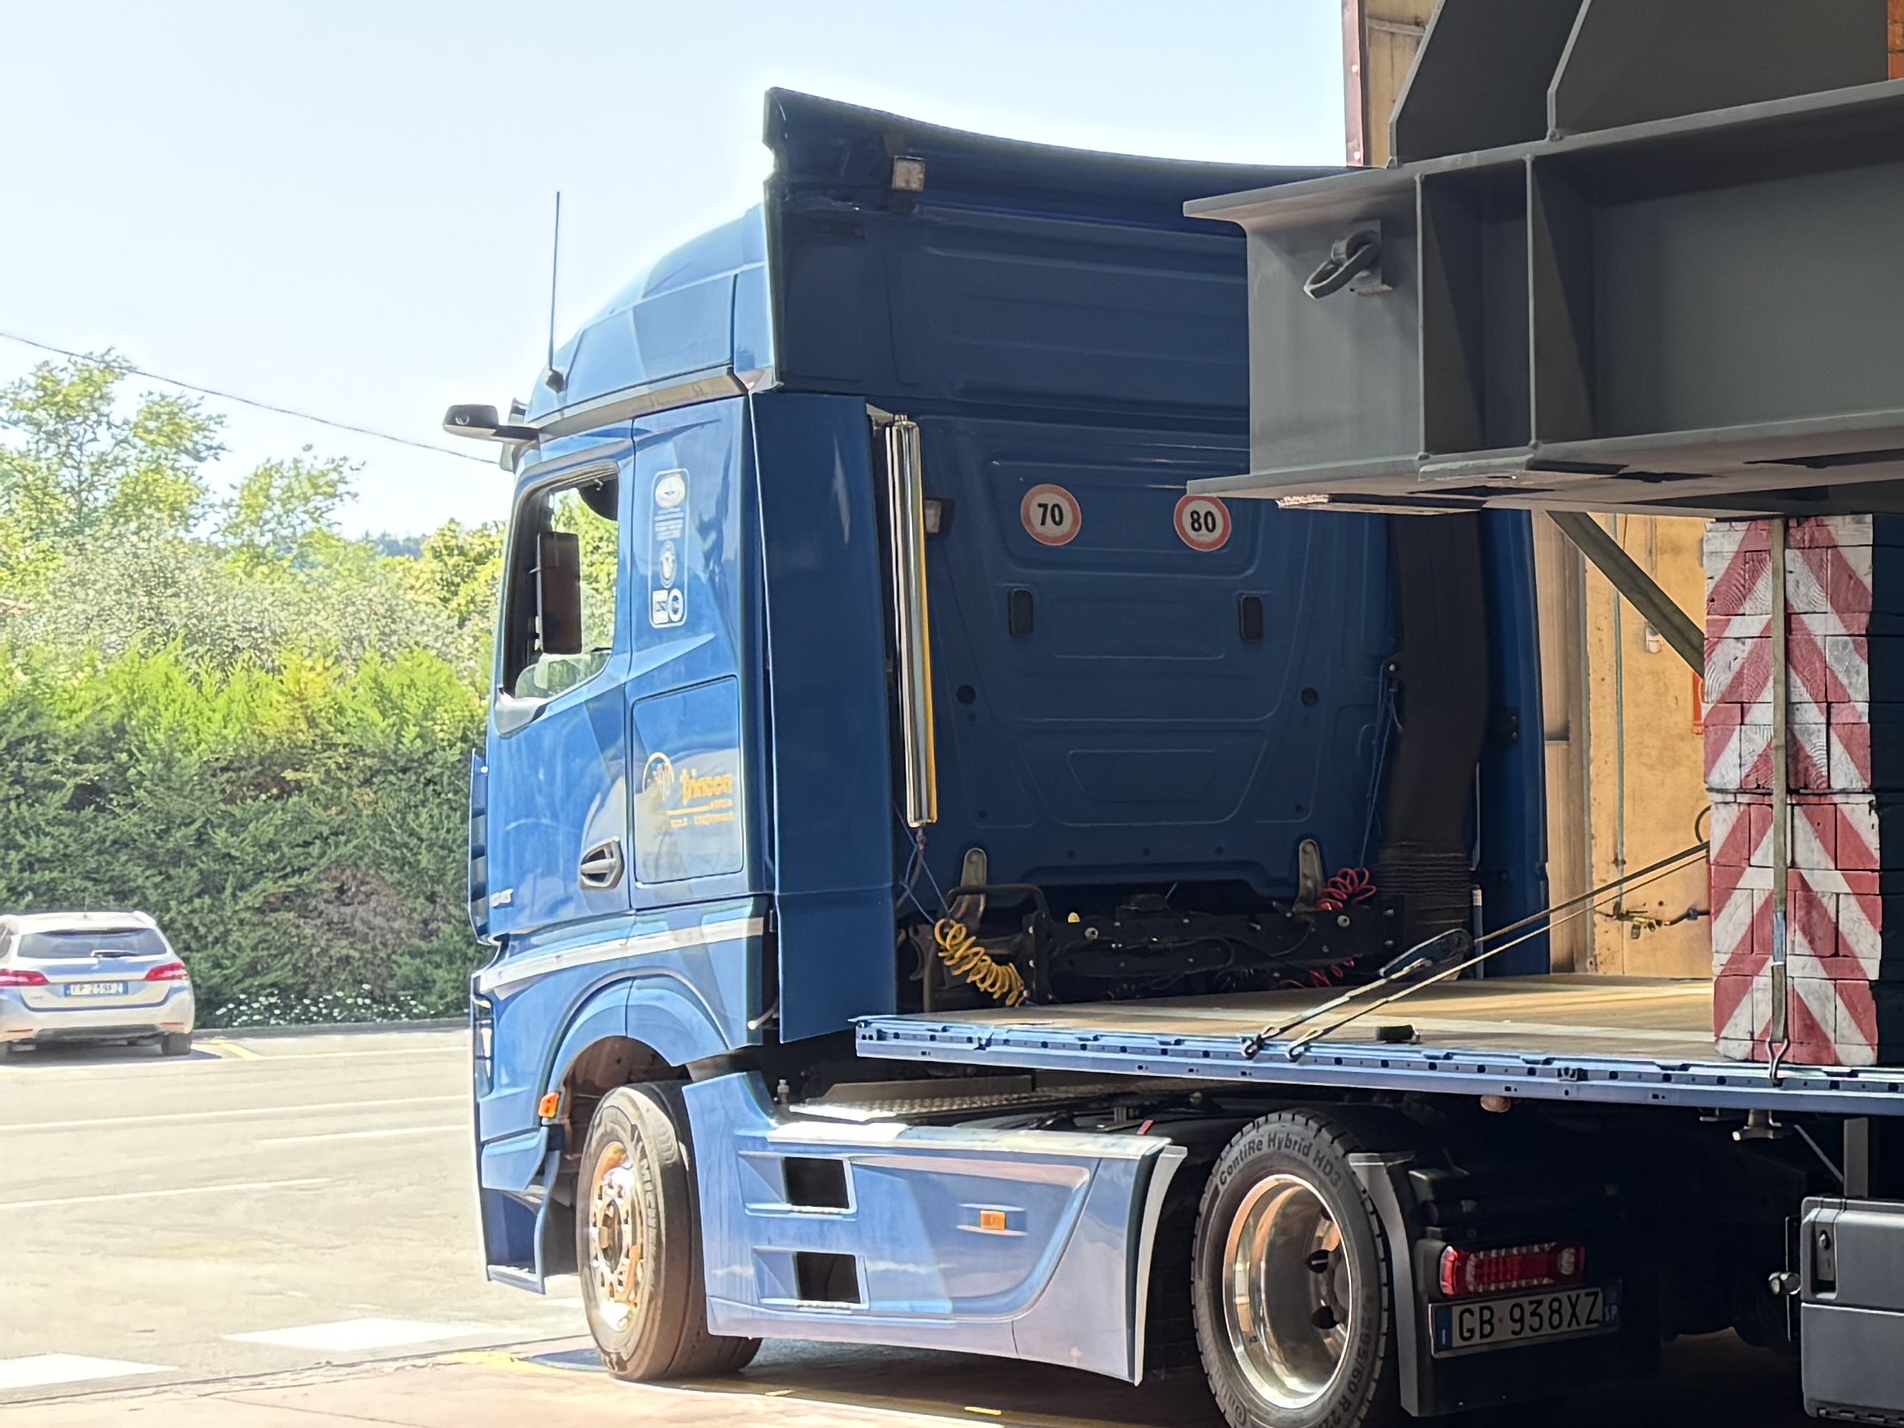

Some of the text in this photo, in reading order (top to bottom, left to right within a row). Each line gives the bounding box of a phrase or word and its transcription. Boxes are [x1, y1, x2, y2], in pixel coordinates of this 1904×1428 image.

[1037, 503, 1064, 526] 70
[1190, 510, 1217, 533] 80
[1267, 1131, 1310, 1158] Hybrid
[1458, 1305, 1495, 1342] GB
[1509, 1290, 1600, 1337] 938XZ
